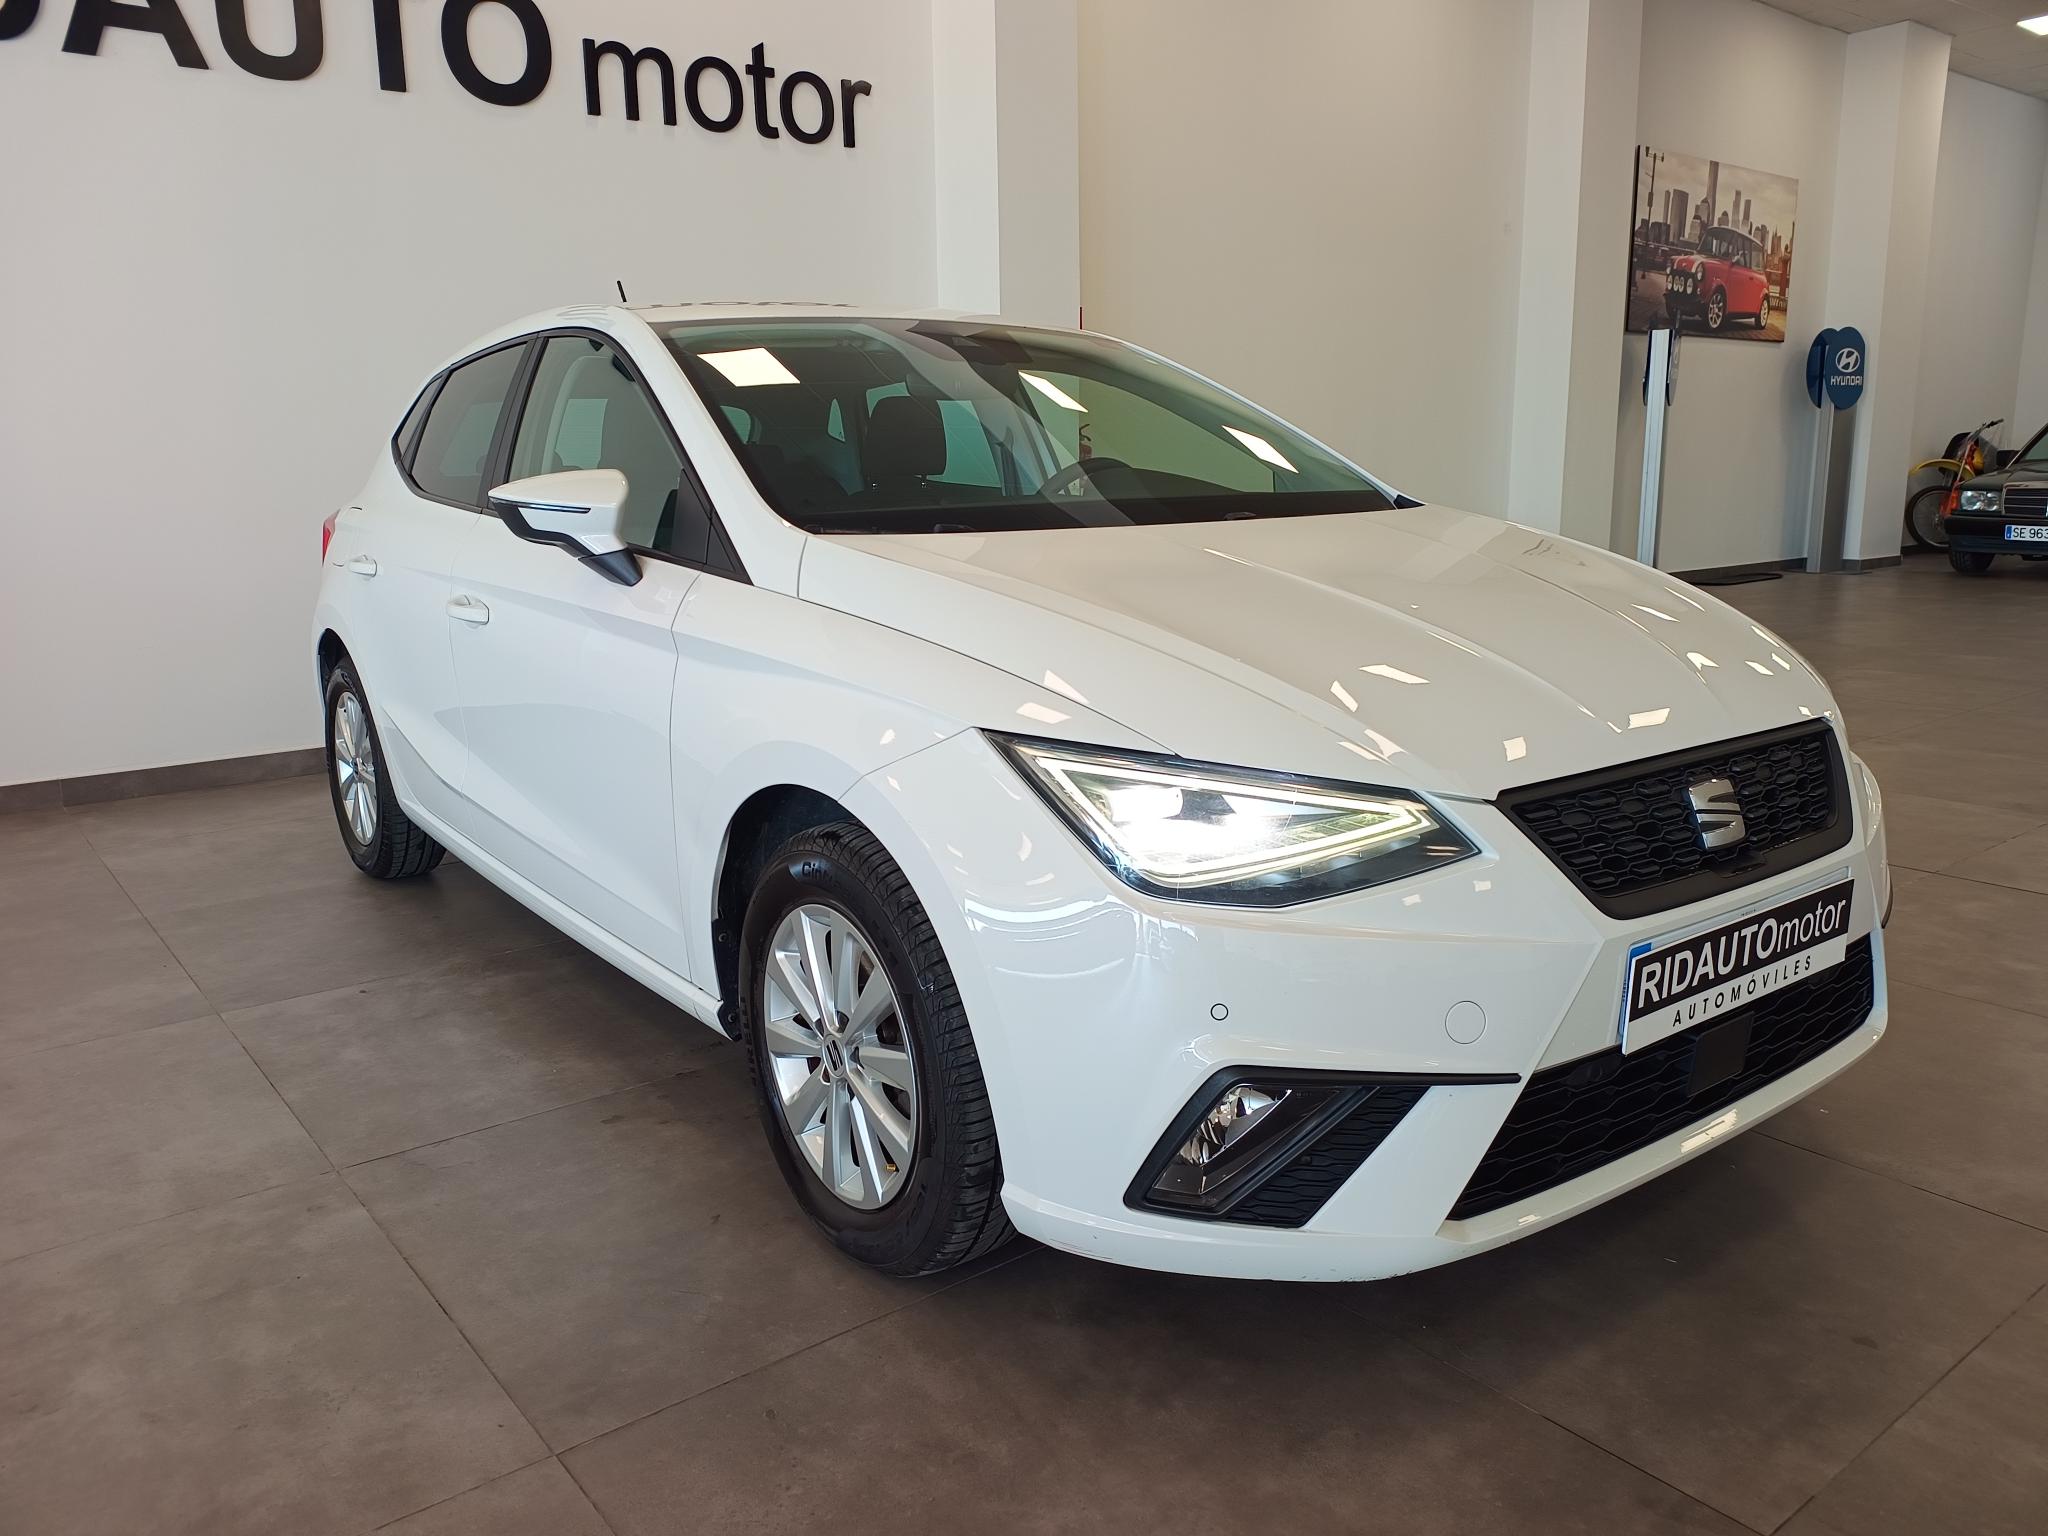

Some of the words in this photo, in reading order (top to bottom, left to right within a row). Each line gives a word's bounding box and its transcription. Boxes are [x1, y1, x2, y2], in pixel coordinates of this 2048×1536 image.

[0, 0, 553, 107] AUTO
[582, 37, 873, 149] motor
[1830, 375, 1863, 386] HYUNDAI
[2012, 527, 2027, 539] SE
[1672, 954, 1812, 1027] AUTOMÓVILES
